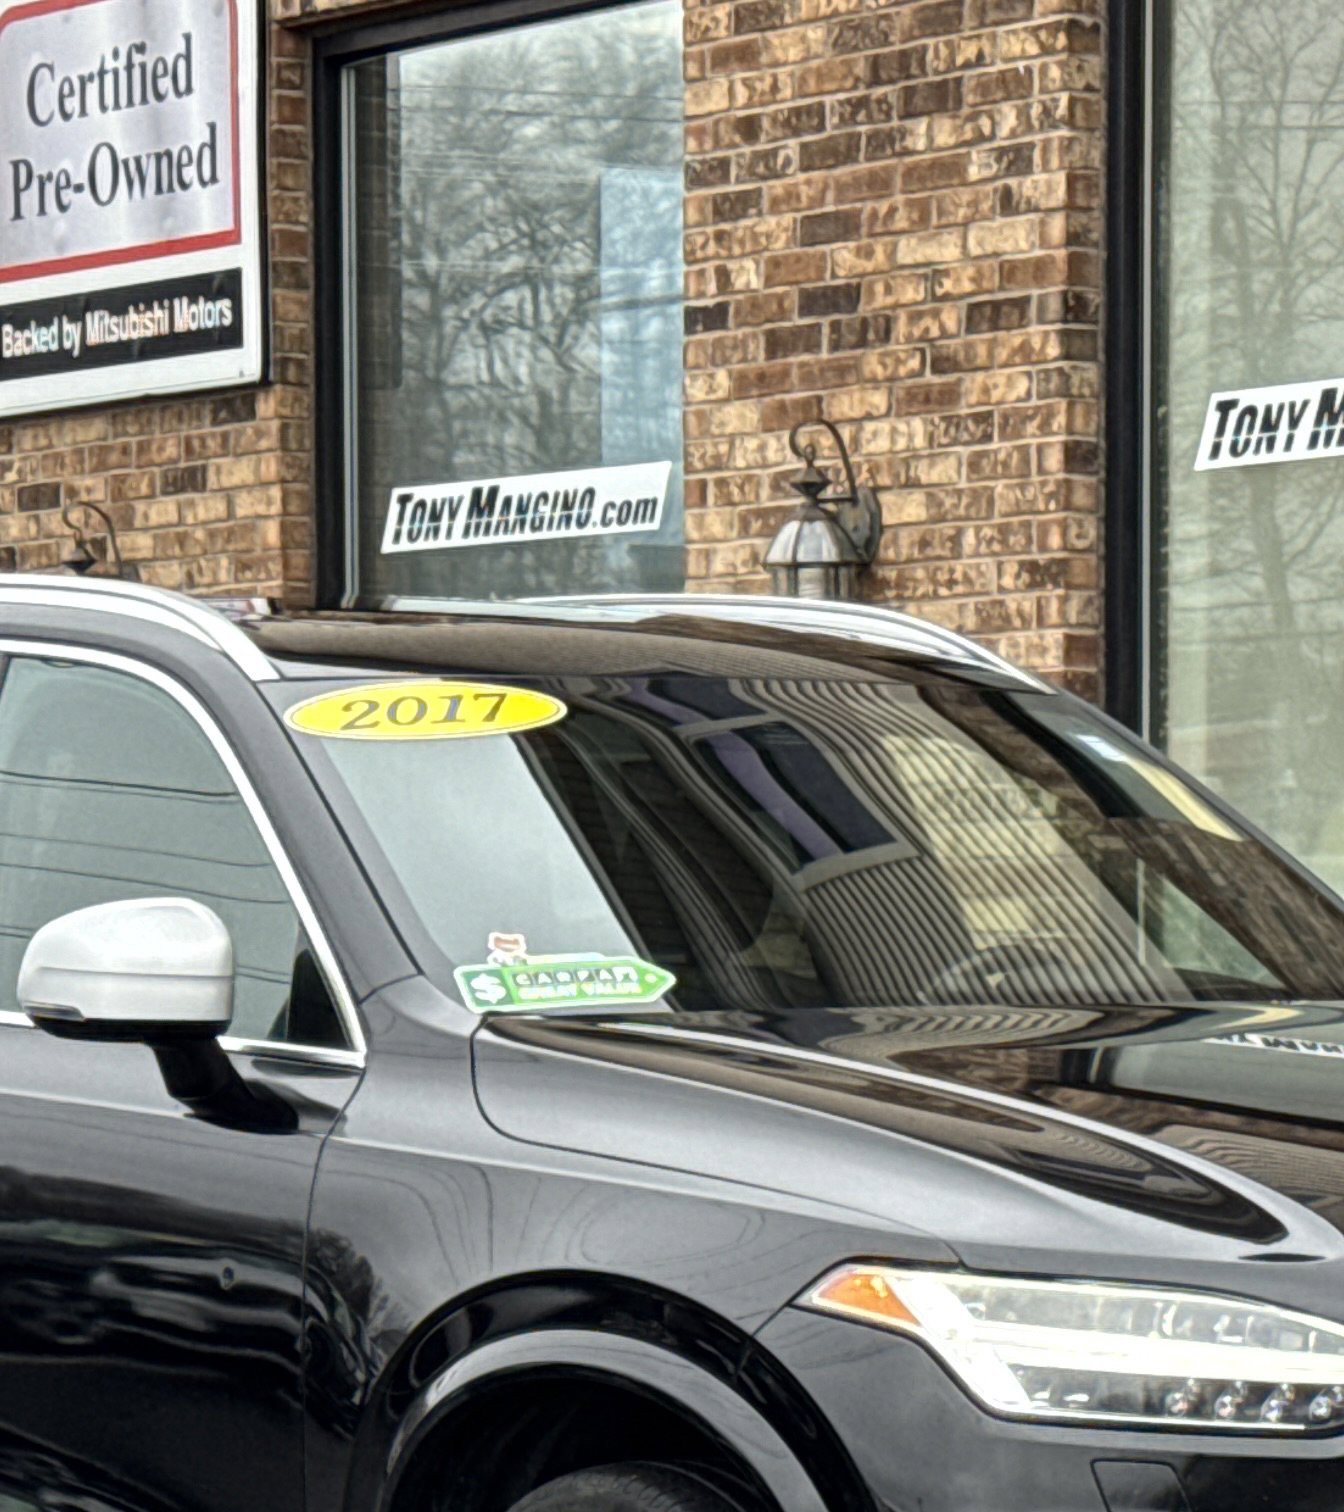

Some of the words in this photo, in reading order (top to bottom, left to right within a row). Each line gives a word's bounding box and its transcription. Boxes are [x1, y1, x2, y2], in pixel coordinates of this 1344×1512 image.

[27, 31, 195, 128] Certified
[8, 121, 220, 222] Pre-Owned
[1, 316, 60, 359] Backed
[61, 314, 83, 359] by
[84, 298, 171, 347] Mitsubishi
[172, 295, 234, 334] Motors
[340, 692, 508, 731] 2017
